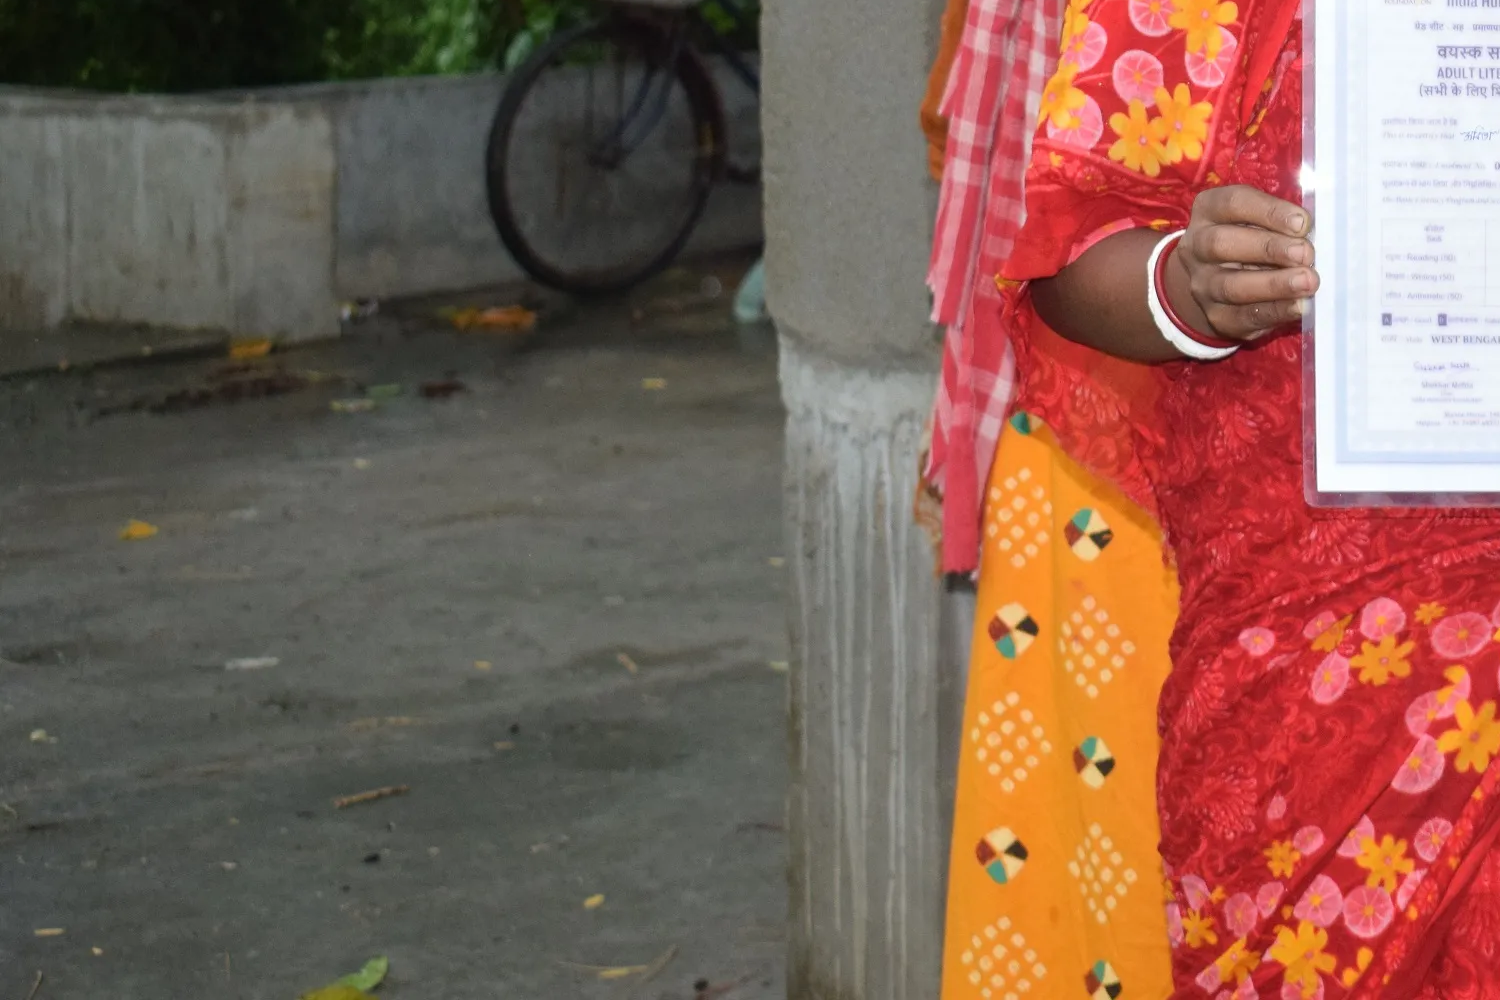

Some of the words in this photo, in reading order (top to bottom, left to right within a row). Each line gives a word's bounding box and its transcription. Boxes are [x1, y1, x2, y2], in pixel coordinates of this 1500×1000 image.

[1436, 45, 1483, 60] वयस्क
[1437, 66, 1475, 80] ADULT
[1418, 82, 1448, 98] (सभी
[1451, 82, 1462, 97] के
[1465, 83, 1488, 99] लिए
[1431, 335, 1461, 345] WEST
